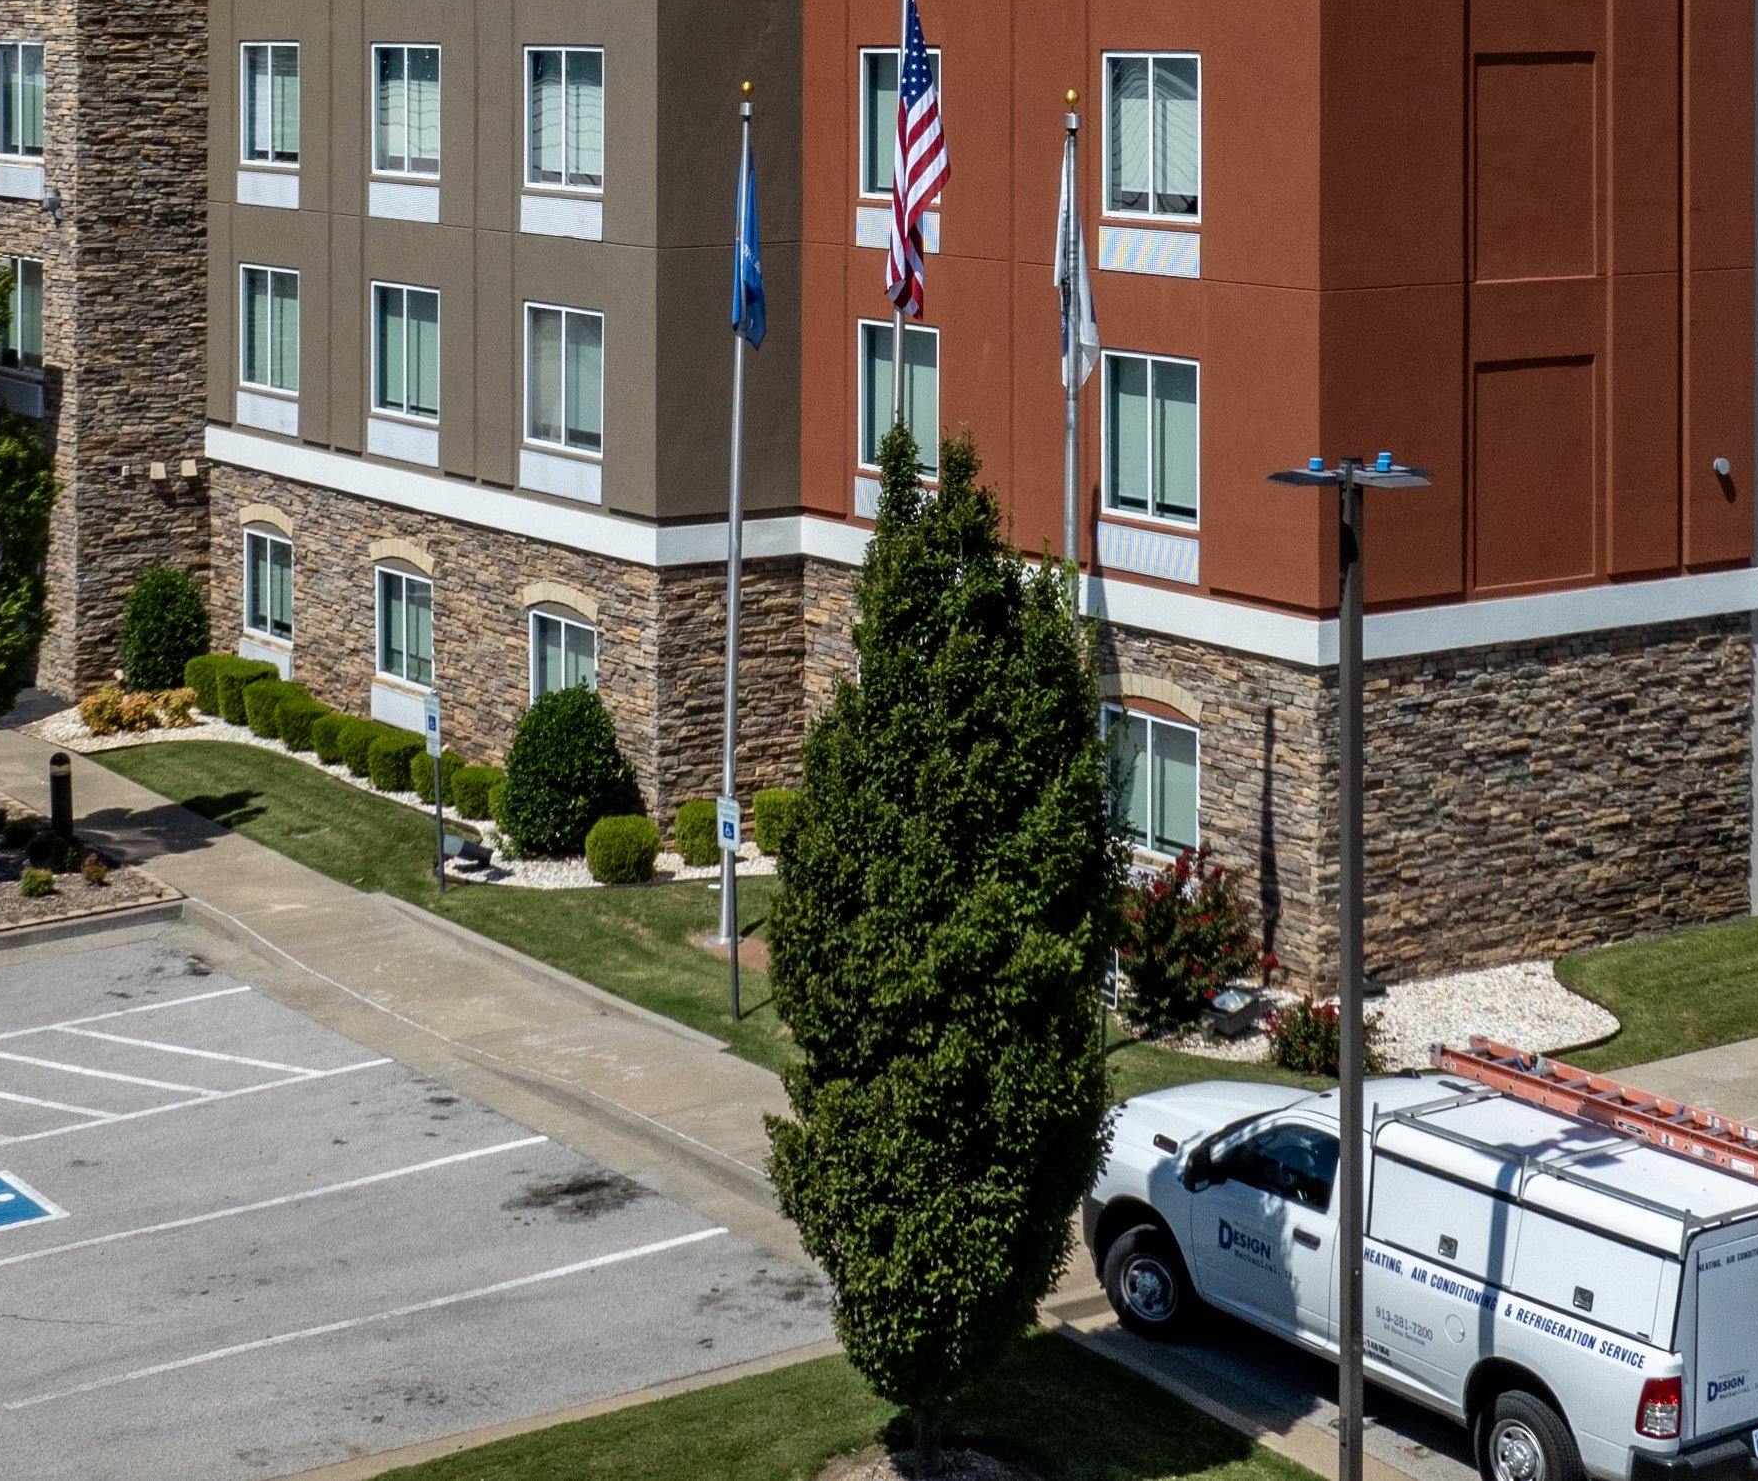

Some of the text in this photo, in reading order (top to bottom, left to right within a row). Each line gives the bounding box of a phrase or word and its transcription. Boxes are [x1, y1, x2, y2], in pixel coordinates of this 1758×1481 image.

[1726, 1254, 1736, 1265] AIR
[1363, 1246, 1647, 1370] HEATING, AIR CONDITIONING & REFRIGERATION SERVICE
[1375, 1305, 1433, 1341] 913-281-7200
